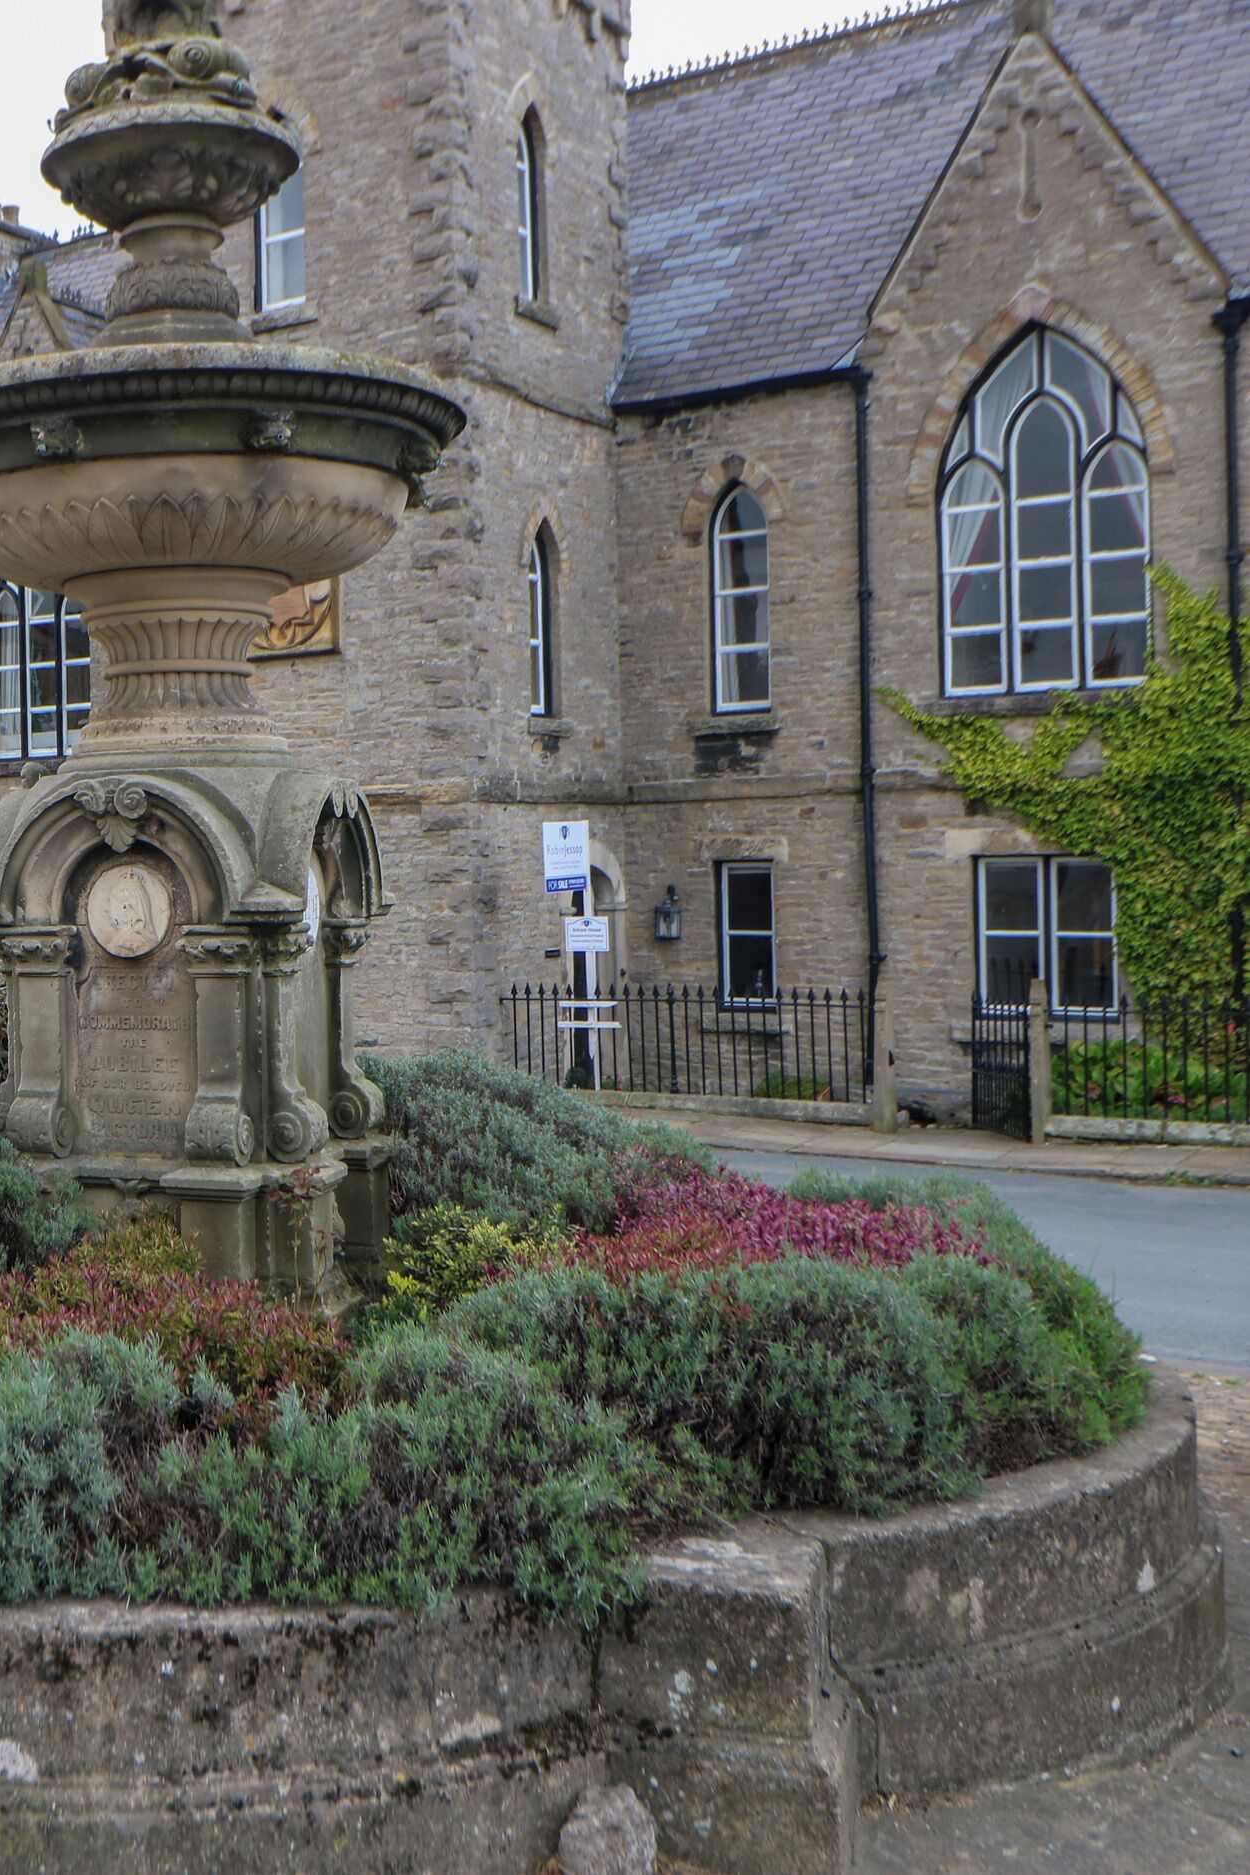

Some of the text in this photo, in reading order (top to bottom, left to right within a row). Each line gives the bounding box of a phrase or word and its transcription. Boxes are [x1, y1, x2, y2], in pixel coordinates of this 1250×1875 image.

[548, 880, 558, 890] FOR
[558, 879, 569, 889] SALE
[79, 1015, 190, 1032] COMMEMORATE
[120, 1038, 147, 1049] THE
[89, 1055, 179, 1074] JUBILEE
[103, 1080, 126, 1090] OUR
[133, 1080, 191, 1092] BELOVED
[89, 1099, 182, 1118] QUEEN
